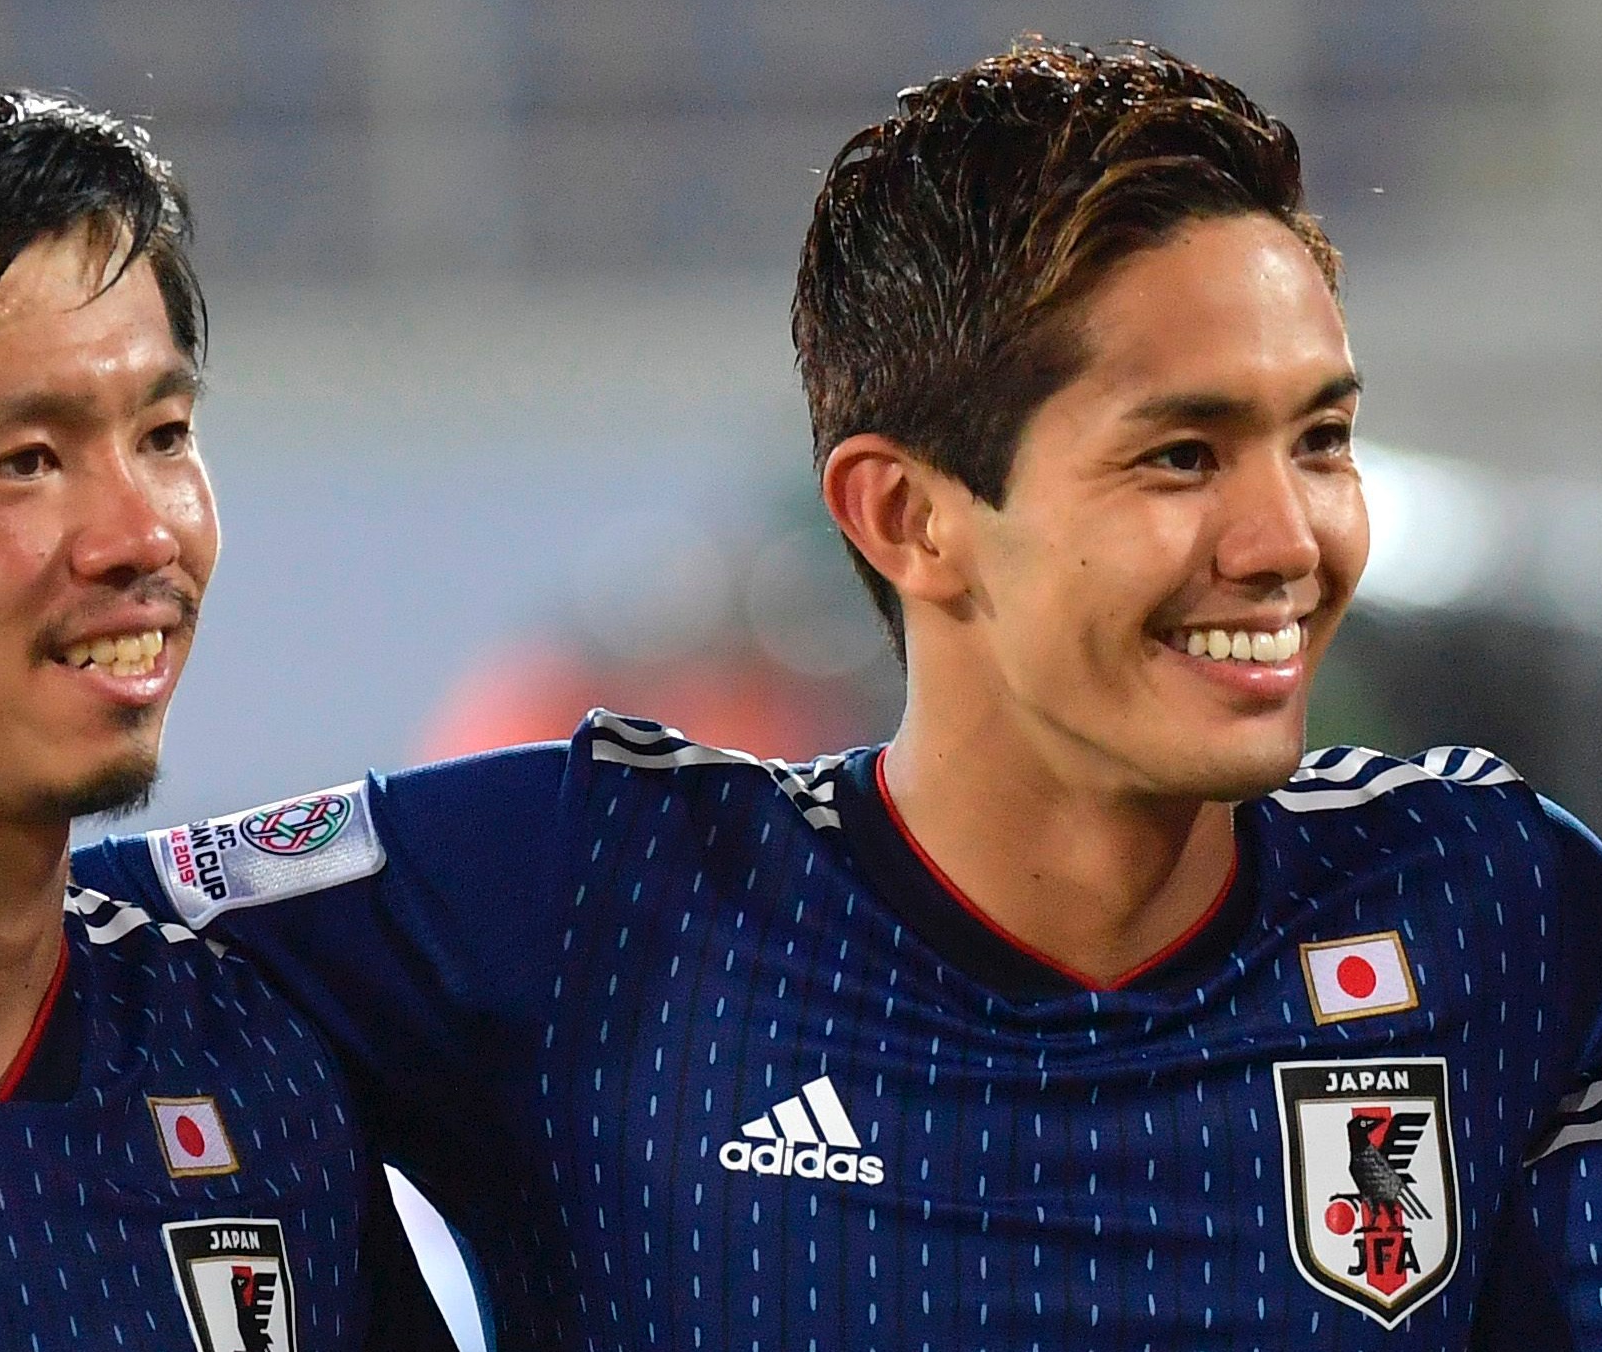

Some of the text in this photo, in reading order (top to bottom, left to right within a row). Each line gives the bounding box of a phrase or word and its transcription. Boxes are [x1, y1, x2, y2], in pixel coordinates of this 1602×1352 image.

[173, 844, 195, 883] 2019
[195, 851, 227, 900] CUP
[1326, 1070, 1410, 1092] JAPAN
[719, 1137, 884, 1185] adidas
[210, 1230, 261, 1250] JAPAN
[1348, 1237, 1421, 1275] JFA
